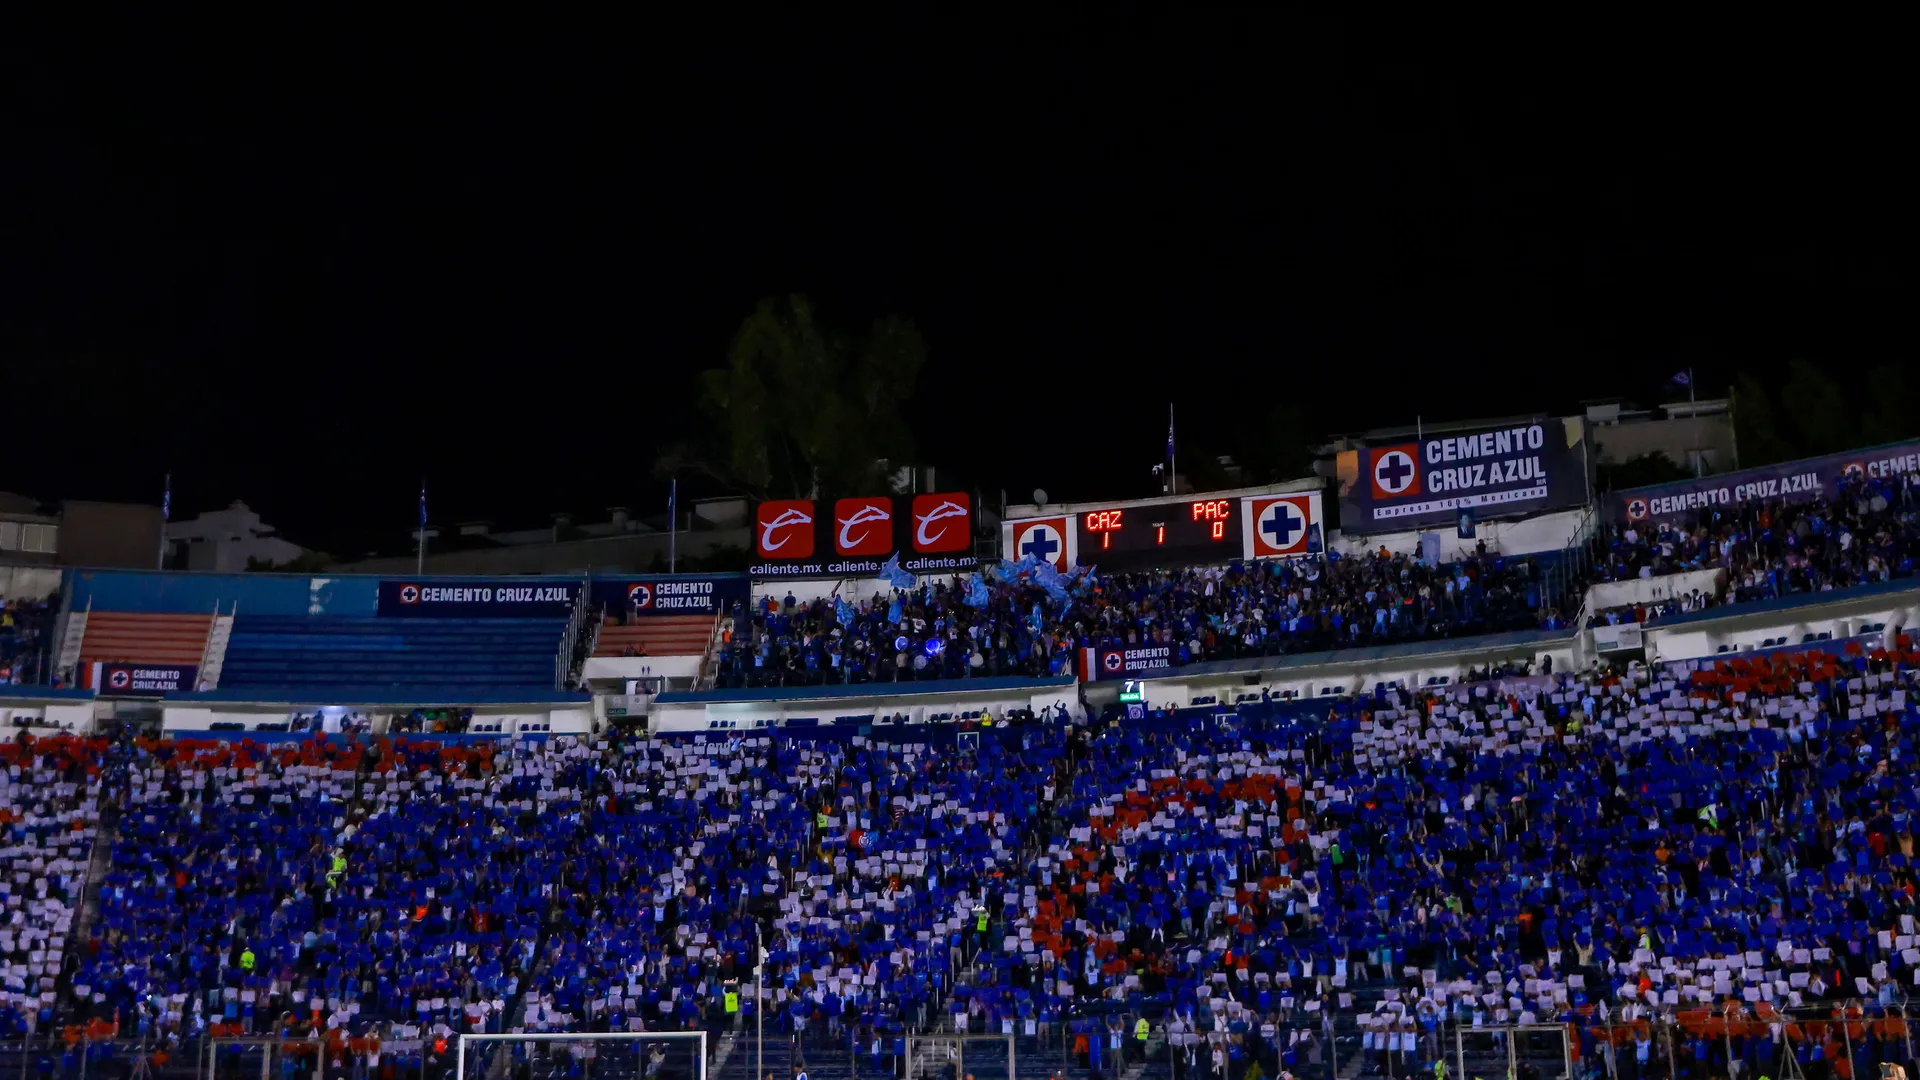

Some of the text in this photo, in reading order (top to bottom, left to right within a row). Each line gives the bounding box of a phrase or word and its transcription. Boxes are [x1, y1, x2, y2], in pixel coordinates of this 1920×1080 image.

[1426, 425, 1544, 464] CEMENTO
[1867, 453, 1920, 478] CEME
[1428, 456, 1546, 493] CRUZ AZUL
[1650, 472, 1823, 515] CEMENTO CRUZ AZUL
[1193, 500, 1230, 521] PAC
[1377, 489, 1544, 516] Empresa 100% Mexicana
[1087, 510, 1122, 530] CAZ
[1158, 526, 1163, 543] 1
[1212, 520, 1223, 538] 0
[1104, 531, 1109, 548] 1
[750, 563, 822, 574] caliente.mx
[906, 555, 978, 569] caliente.mx
[421, 587, 570, 602] CEMENTO CRUZ AZUL
[656, 582, 713, 595] CEMENTO
[656, 595, 713, 608] CRUZ AZUL
[1125, 647, 1170, 659] CEMENTO
[1125, 658, 1170, 670] CRUZ AZUL
[133, 669, 180, 679] CEMENTO
[132, 680, 179, 690] CRUZ AZUL
